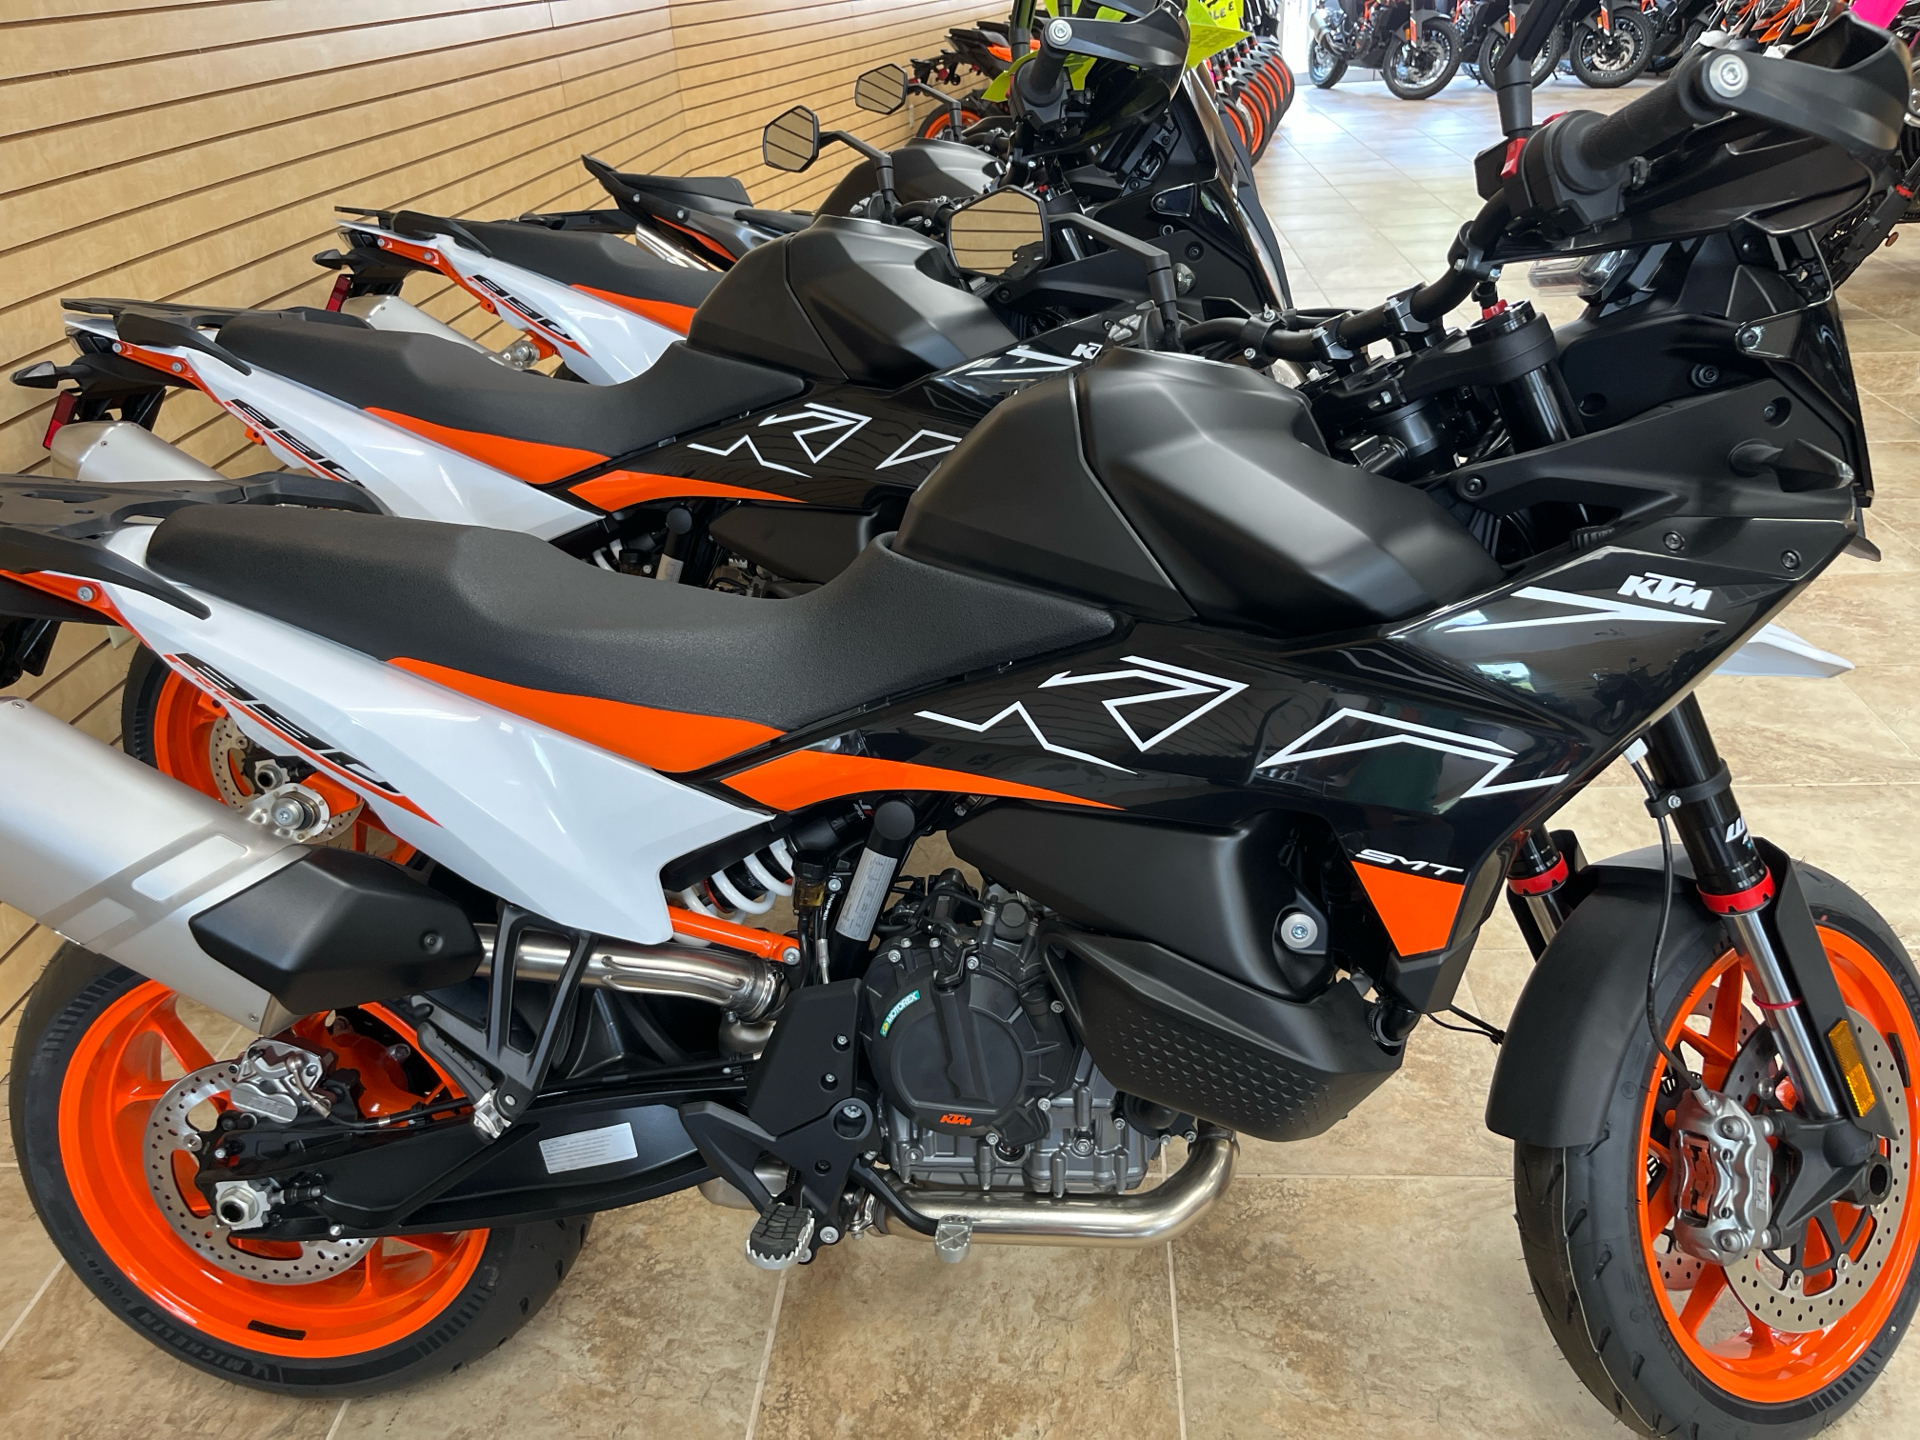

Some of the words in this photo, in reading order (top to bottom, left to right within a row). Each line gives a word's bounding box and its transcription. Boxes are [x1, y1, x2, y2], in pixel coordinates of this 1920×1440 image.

[1617, 571, 1712, 611] KTM
[1355, 849, 1464, 876] SMT
[886, 990, 920, 1025] MOTOREX
[940, 1113, 972, 1126] KTM
[1754, 1158, 1768, 1212] KTM
[137, 1312, 249, 1373] MICHELIN
